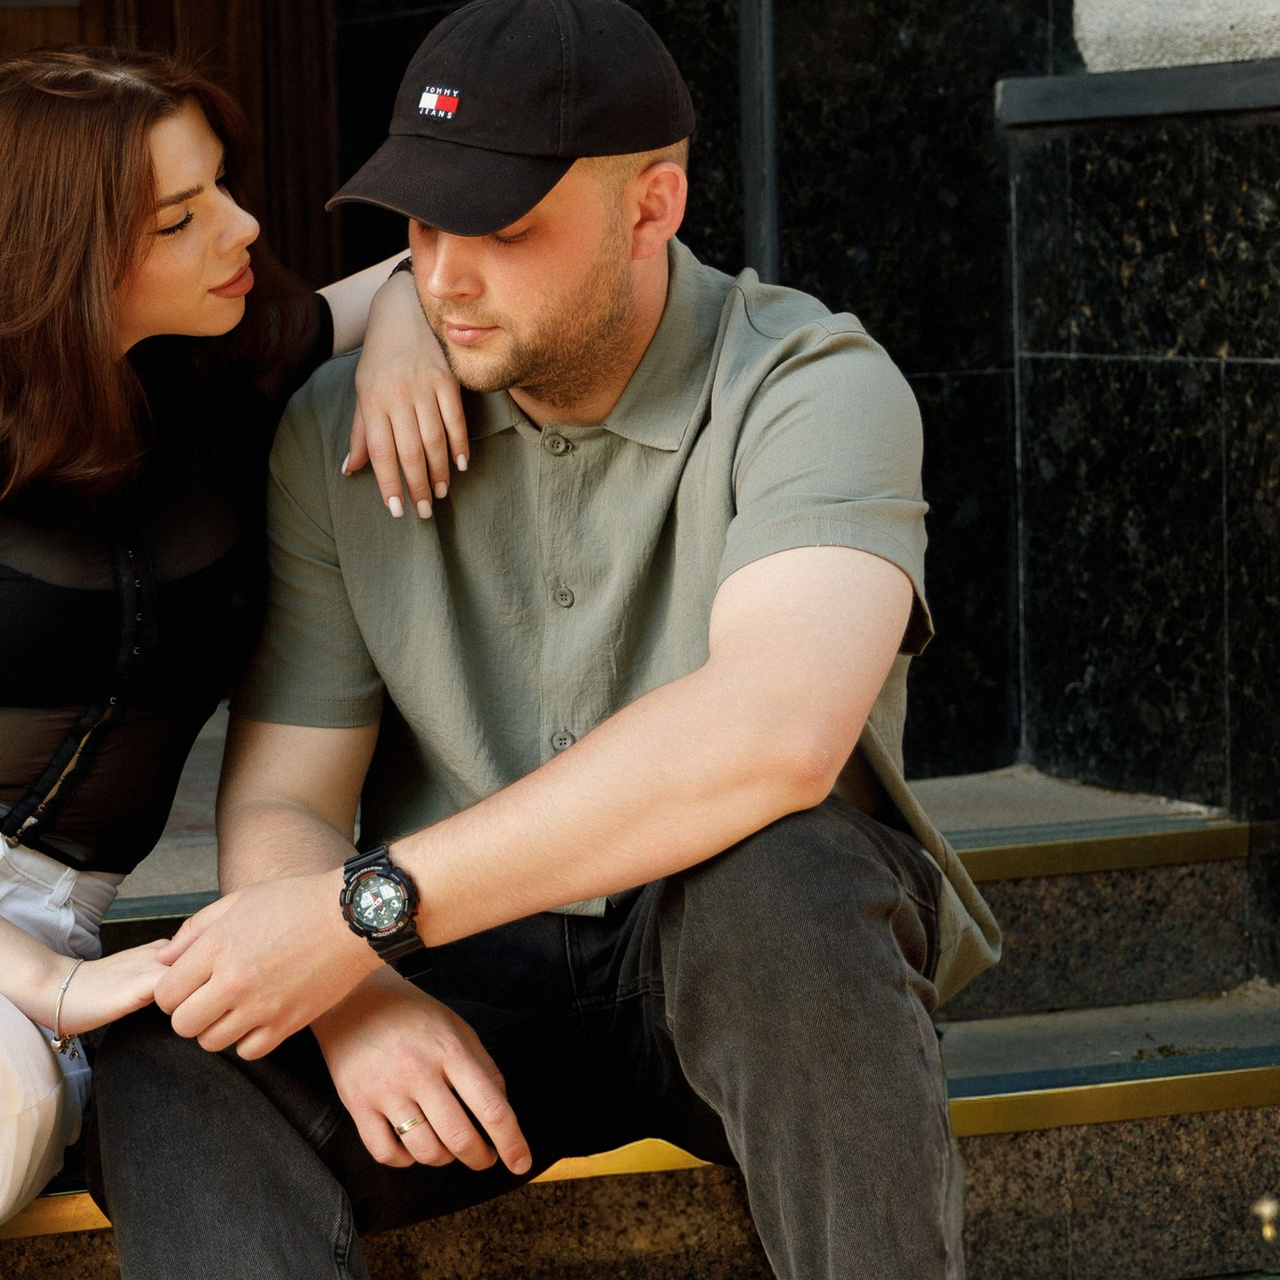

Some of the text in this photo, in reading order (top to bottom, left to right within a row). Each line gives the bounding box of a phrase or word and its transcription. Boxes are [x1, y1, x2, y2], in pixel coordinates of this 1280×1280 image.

[425, 86, 459, 98] TOMMY
[419, 108, 453, 119] JEANS
[371, 921, 404, 938] G-SHOCK
